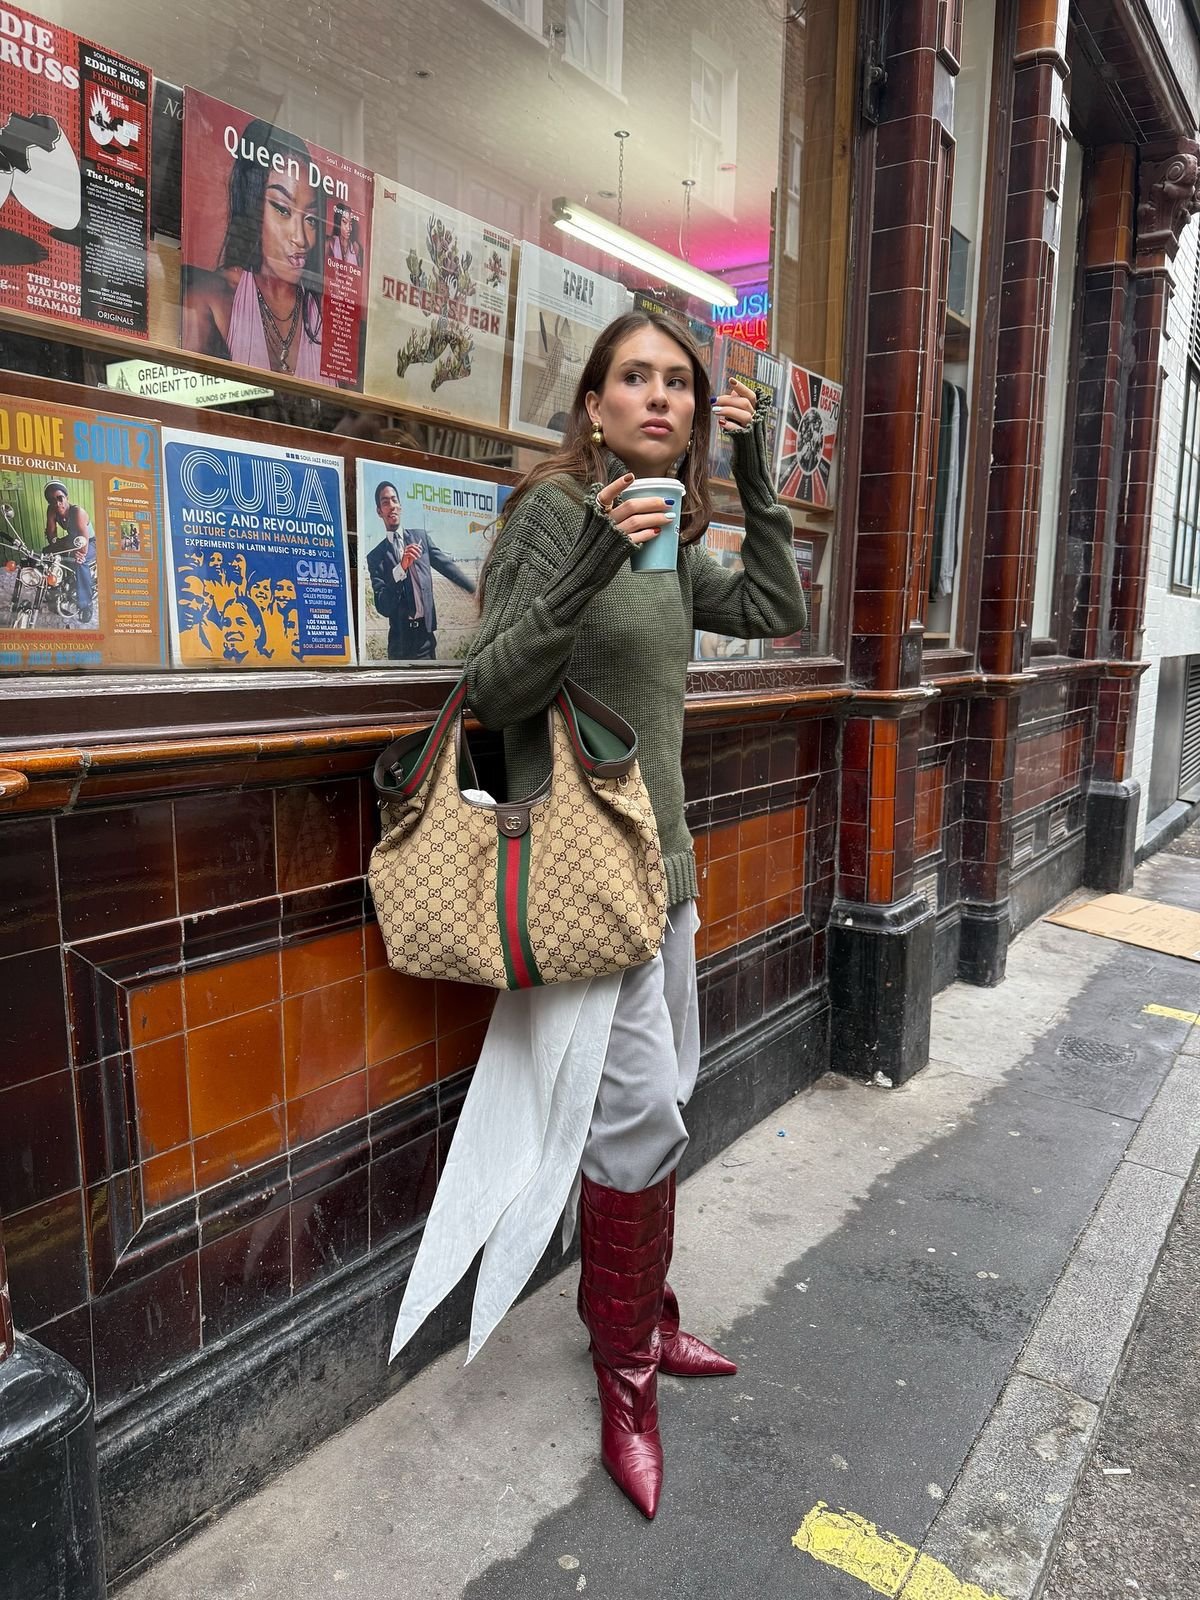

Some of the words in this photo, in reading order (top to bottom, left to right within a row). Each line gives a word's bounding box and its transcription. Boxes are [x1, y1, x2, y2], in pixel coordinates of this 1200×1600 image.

[0, 36, 81, 90] RUSS
[84, 55, 118, 78] EDDIE
[119, 71, 146, 90] RUSS
[93, 51, 106, 62] SOUL
[107, 57, 119, 67] JAZZ
[119, 62, 140, 76] RECORDS
[92, 70, 120, 90] FRESH
[121, 83, 140, 98] OUT
[101, 87, 124, 103] EDDIE
[111, 99, 130, 112] RUSS
[223, 126, 300, 181] Queen
[309, 162, 349, 202] Dem
[86, 168, 103, 181] The
[104, 174, 124, 188] Lope
[125, 182, 145, 198] Song
[327, 257, 348, 272] Queen
[349, 265, 361, 277] Dem
[27, 272, 51, 287] THE
[53, 280, 82, 296] LOPE
[382, 276, 443, 315] TREES
[97, 310, 134, 326] ORIGINALS
[138, 366, 168, 382] GREAT
[139, 379, 183, 395] ANCIENT
[185, 376, 198, 389] TO
[195, 393, 219, 404] SOUNDS
[220, 392, 229, 400] OF
[229, 390, 240, 399] THE
[820, 396, 832, 414] USA
[16, 411, 65, 458] ONE
[73, 420, 133, 469] SOUL
[136, 431, 151, 470] 2
[0, 454, 25, 467] THE
[26, 458, 81, 474] ORIGINAL
[180, 450, 334, 523] CUBA
[406, 482, 451, 505] JACKIE
[182, 508, 227, 525] MUSIC
[231, 513, 259, 529] AND
[262, 517, 335, 537] REVOLUTION
[183, 524, 225, 537] CULTURE
[229, 528, 259, 540] CLASH
[262, 532, 271, 541] IN
[274, 533, 310, 545] HAVANA
[312, 537, 336, 548] CUBA
[185, 538, 235, 550] EXPERIMENTS
[246, 543, 266, 552] LATIN
[268, 545, 289, 554] MUSIC
[291, 547, 317, 557] 1975-85
[296, 560, 339, 580] CUBA
[3, 642, 38, 651] TODAY'S
[39, 642, 67, 651] SOUND
[67, 642, 95, 651] TODAY
